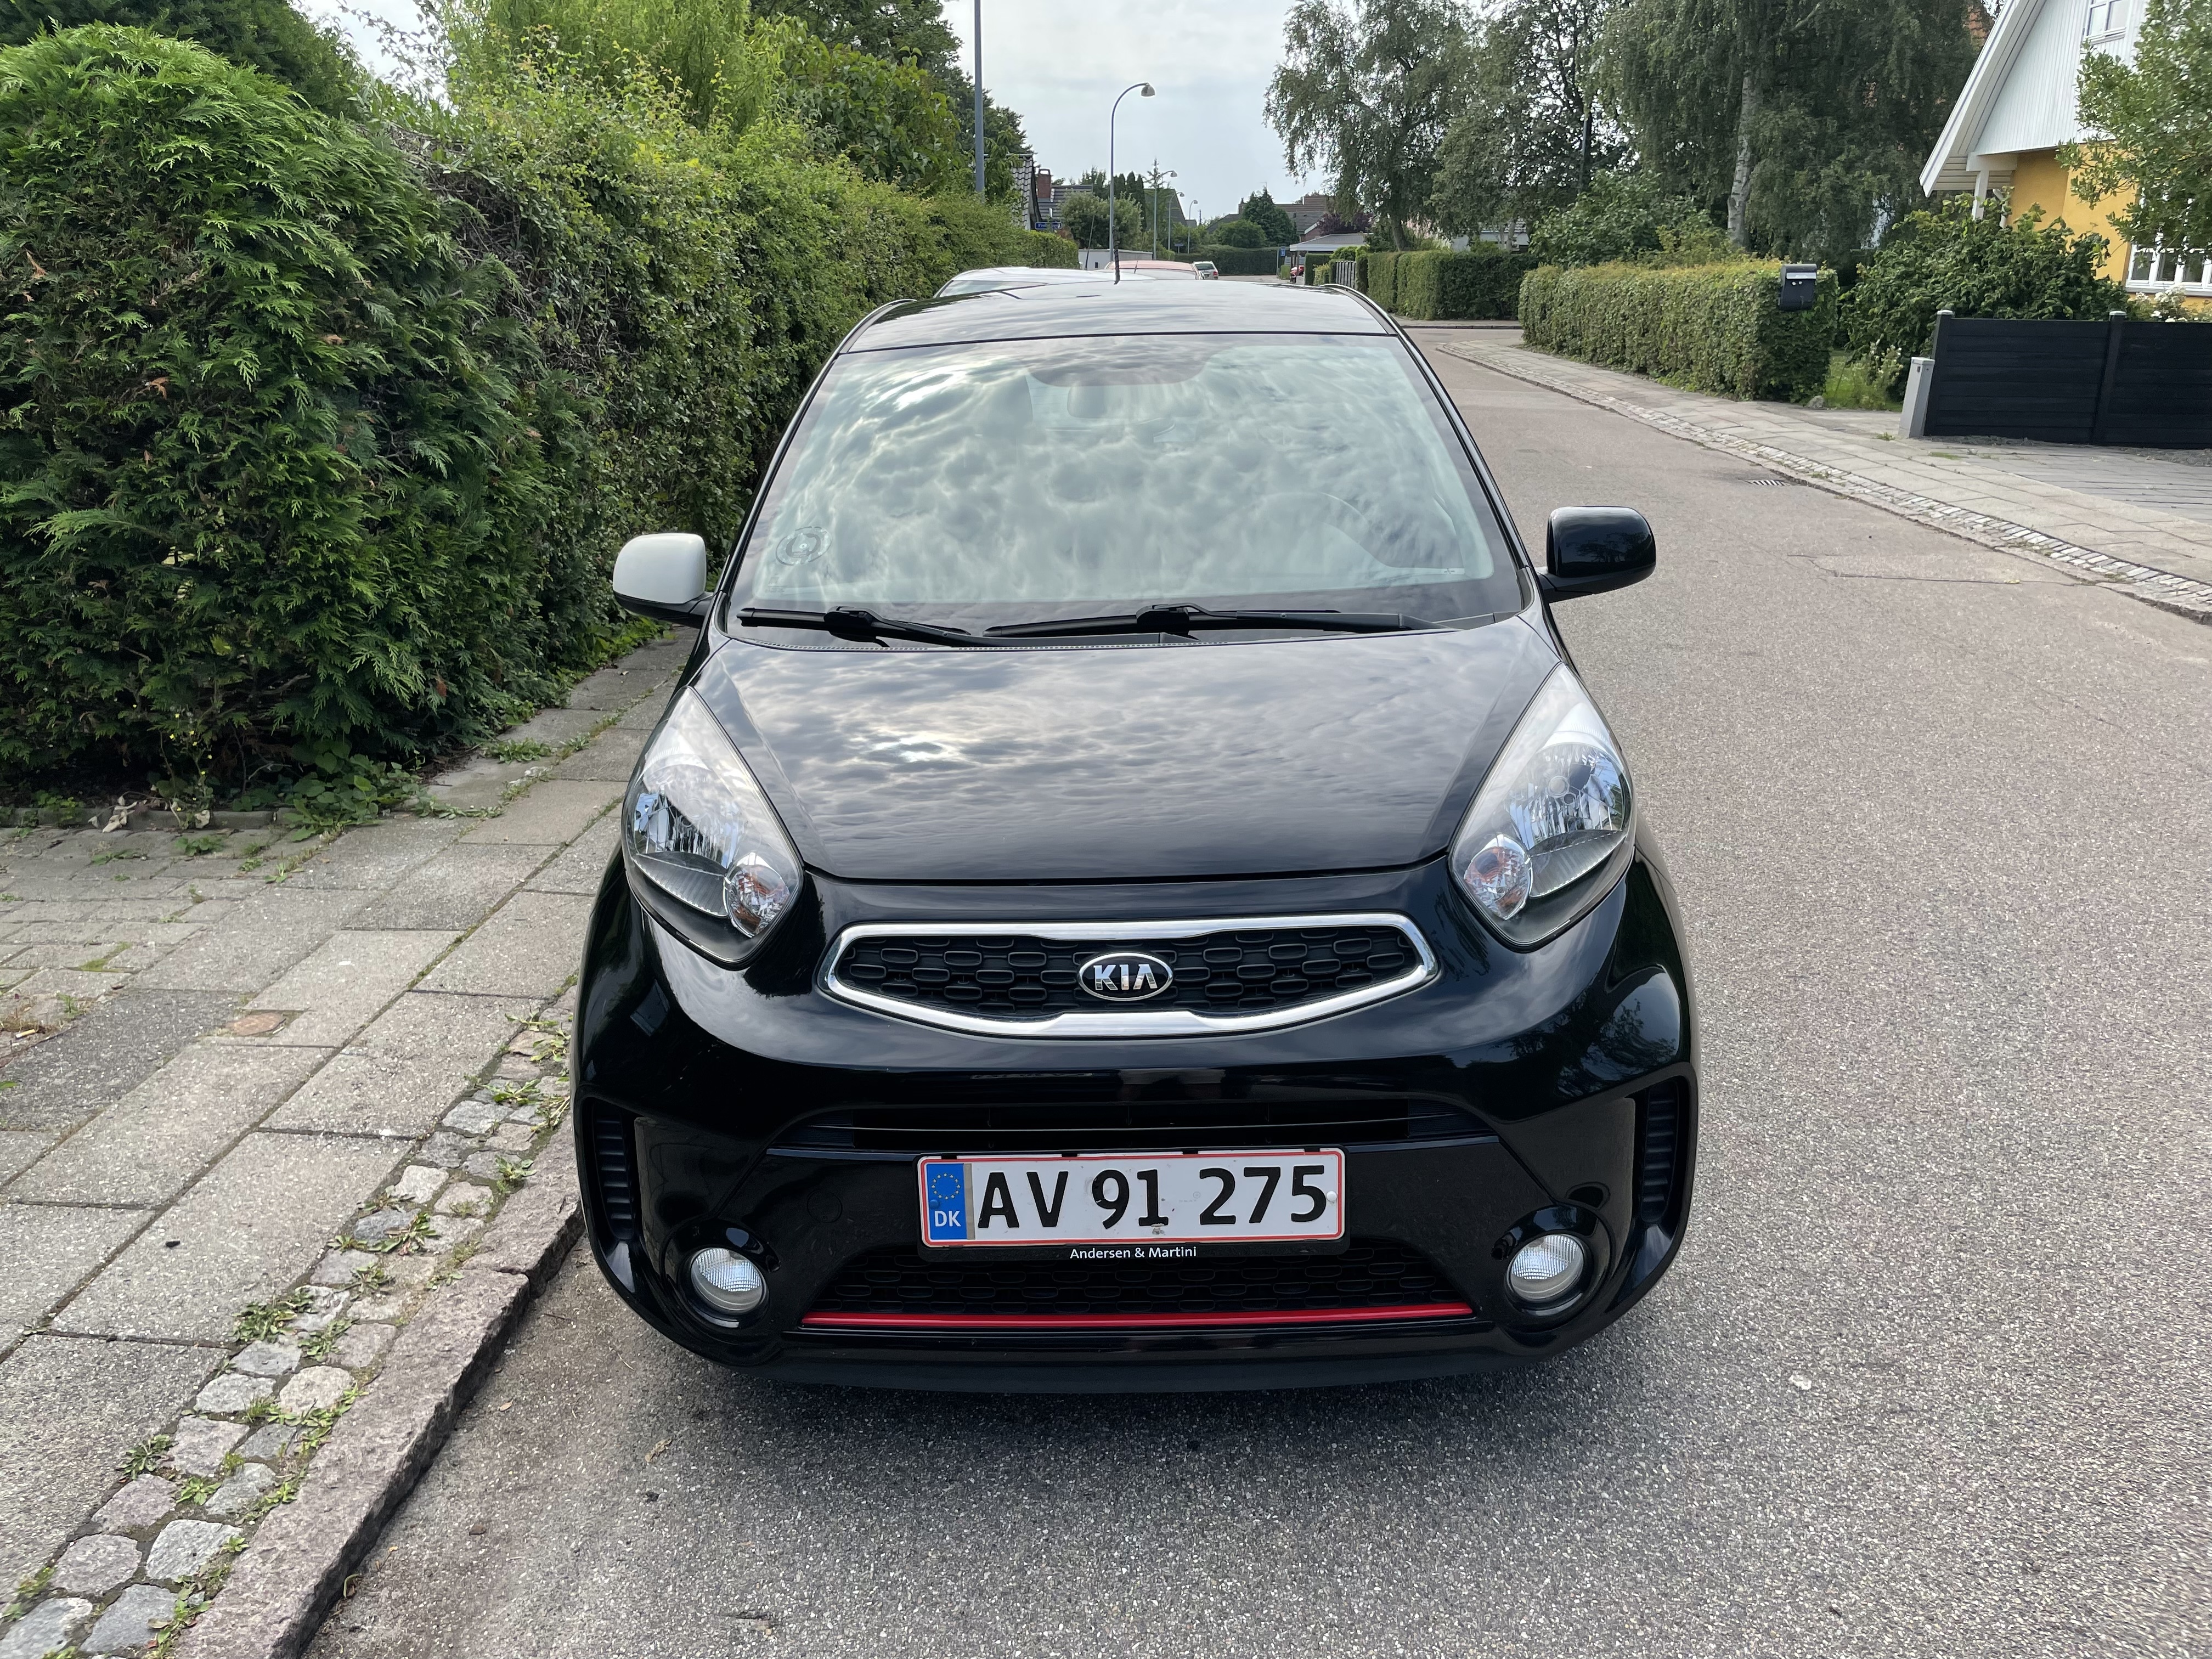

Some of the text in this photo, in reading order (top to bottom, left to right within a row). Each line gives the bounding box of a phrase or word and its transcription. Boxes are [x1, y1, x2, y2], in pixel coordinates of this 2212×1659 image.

[1093, 963, 1158, 991] KIA
[977, 1165, 1327, 1229] AV 91 275
[934, 1210, 962, 1227] DK
[1070, 1246, 1197, 1259] Andersen & Martini
